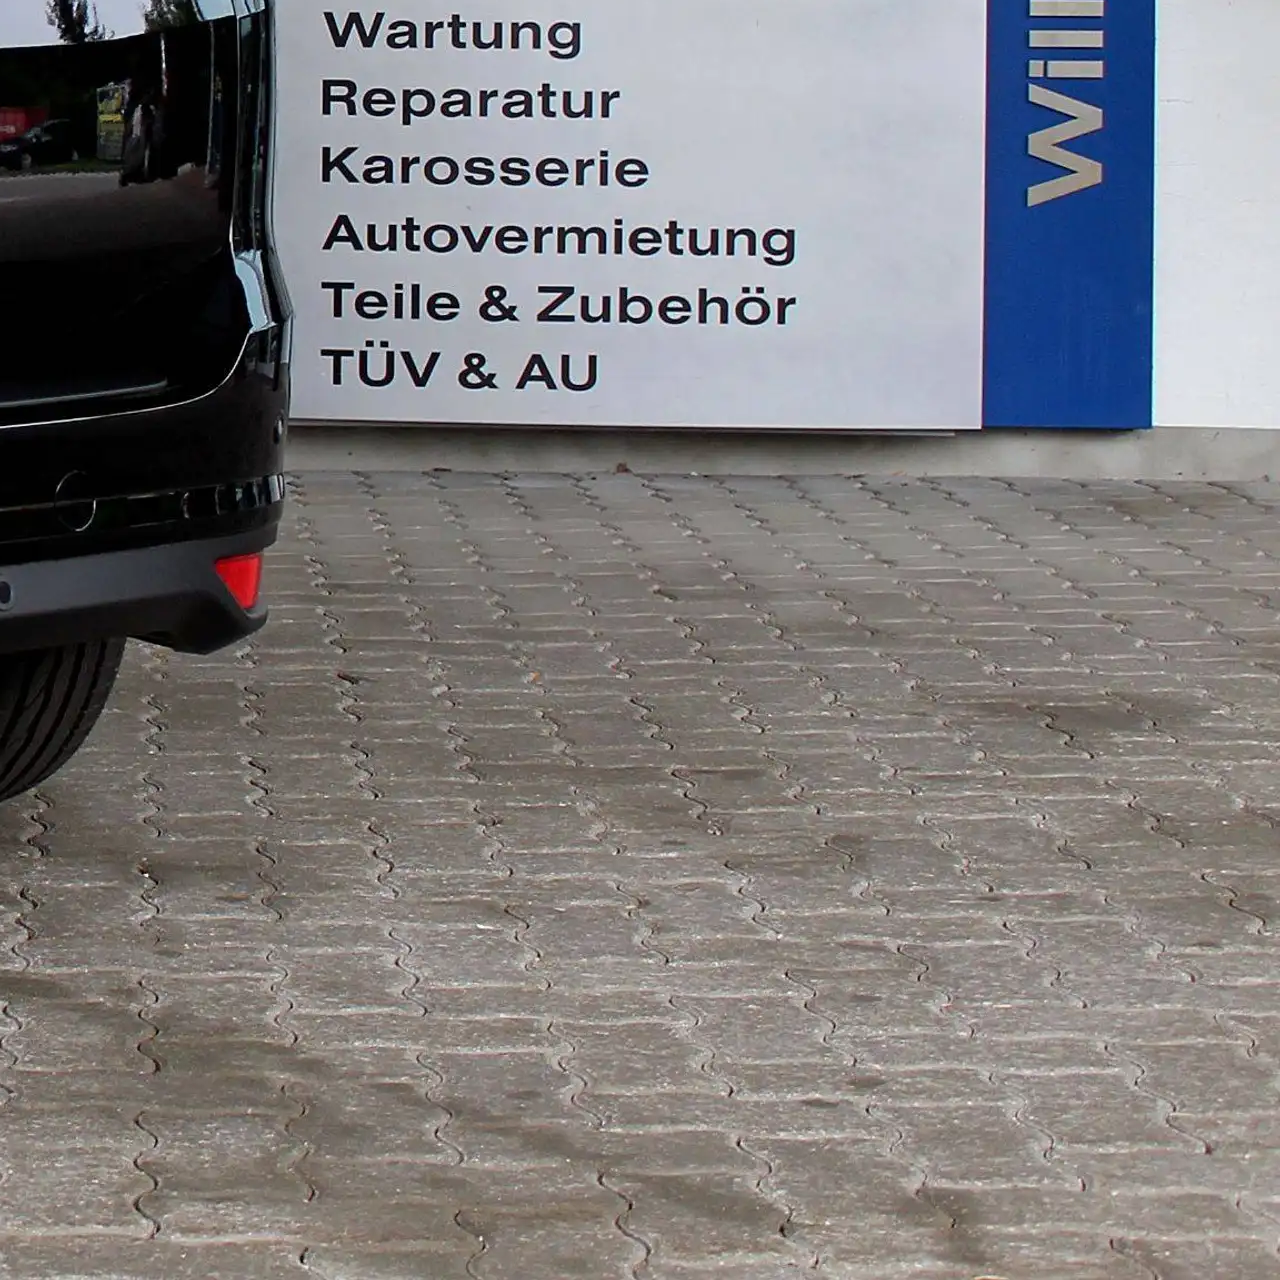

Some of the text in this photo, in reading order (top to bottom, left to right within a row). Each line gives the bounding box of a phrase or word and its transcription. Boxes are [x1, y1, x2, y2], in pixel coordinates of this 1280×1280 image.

[323, 11, 582, 60] Wartung
[321, 79, 621, 126] Reparatur
[321, 146, 650, 188] Karosserie
[321, 214, 796, 267] Autovermietung
[320, 281, 797, 326] Teile & Zubehör
[320, 339, 599, 392] TÜV & AU
